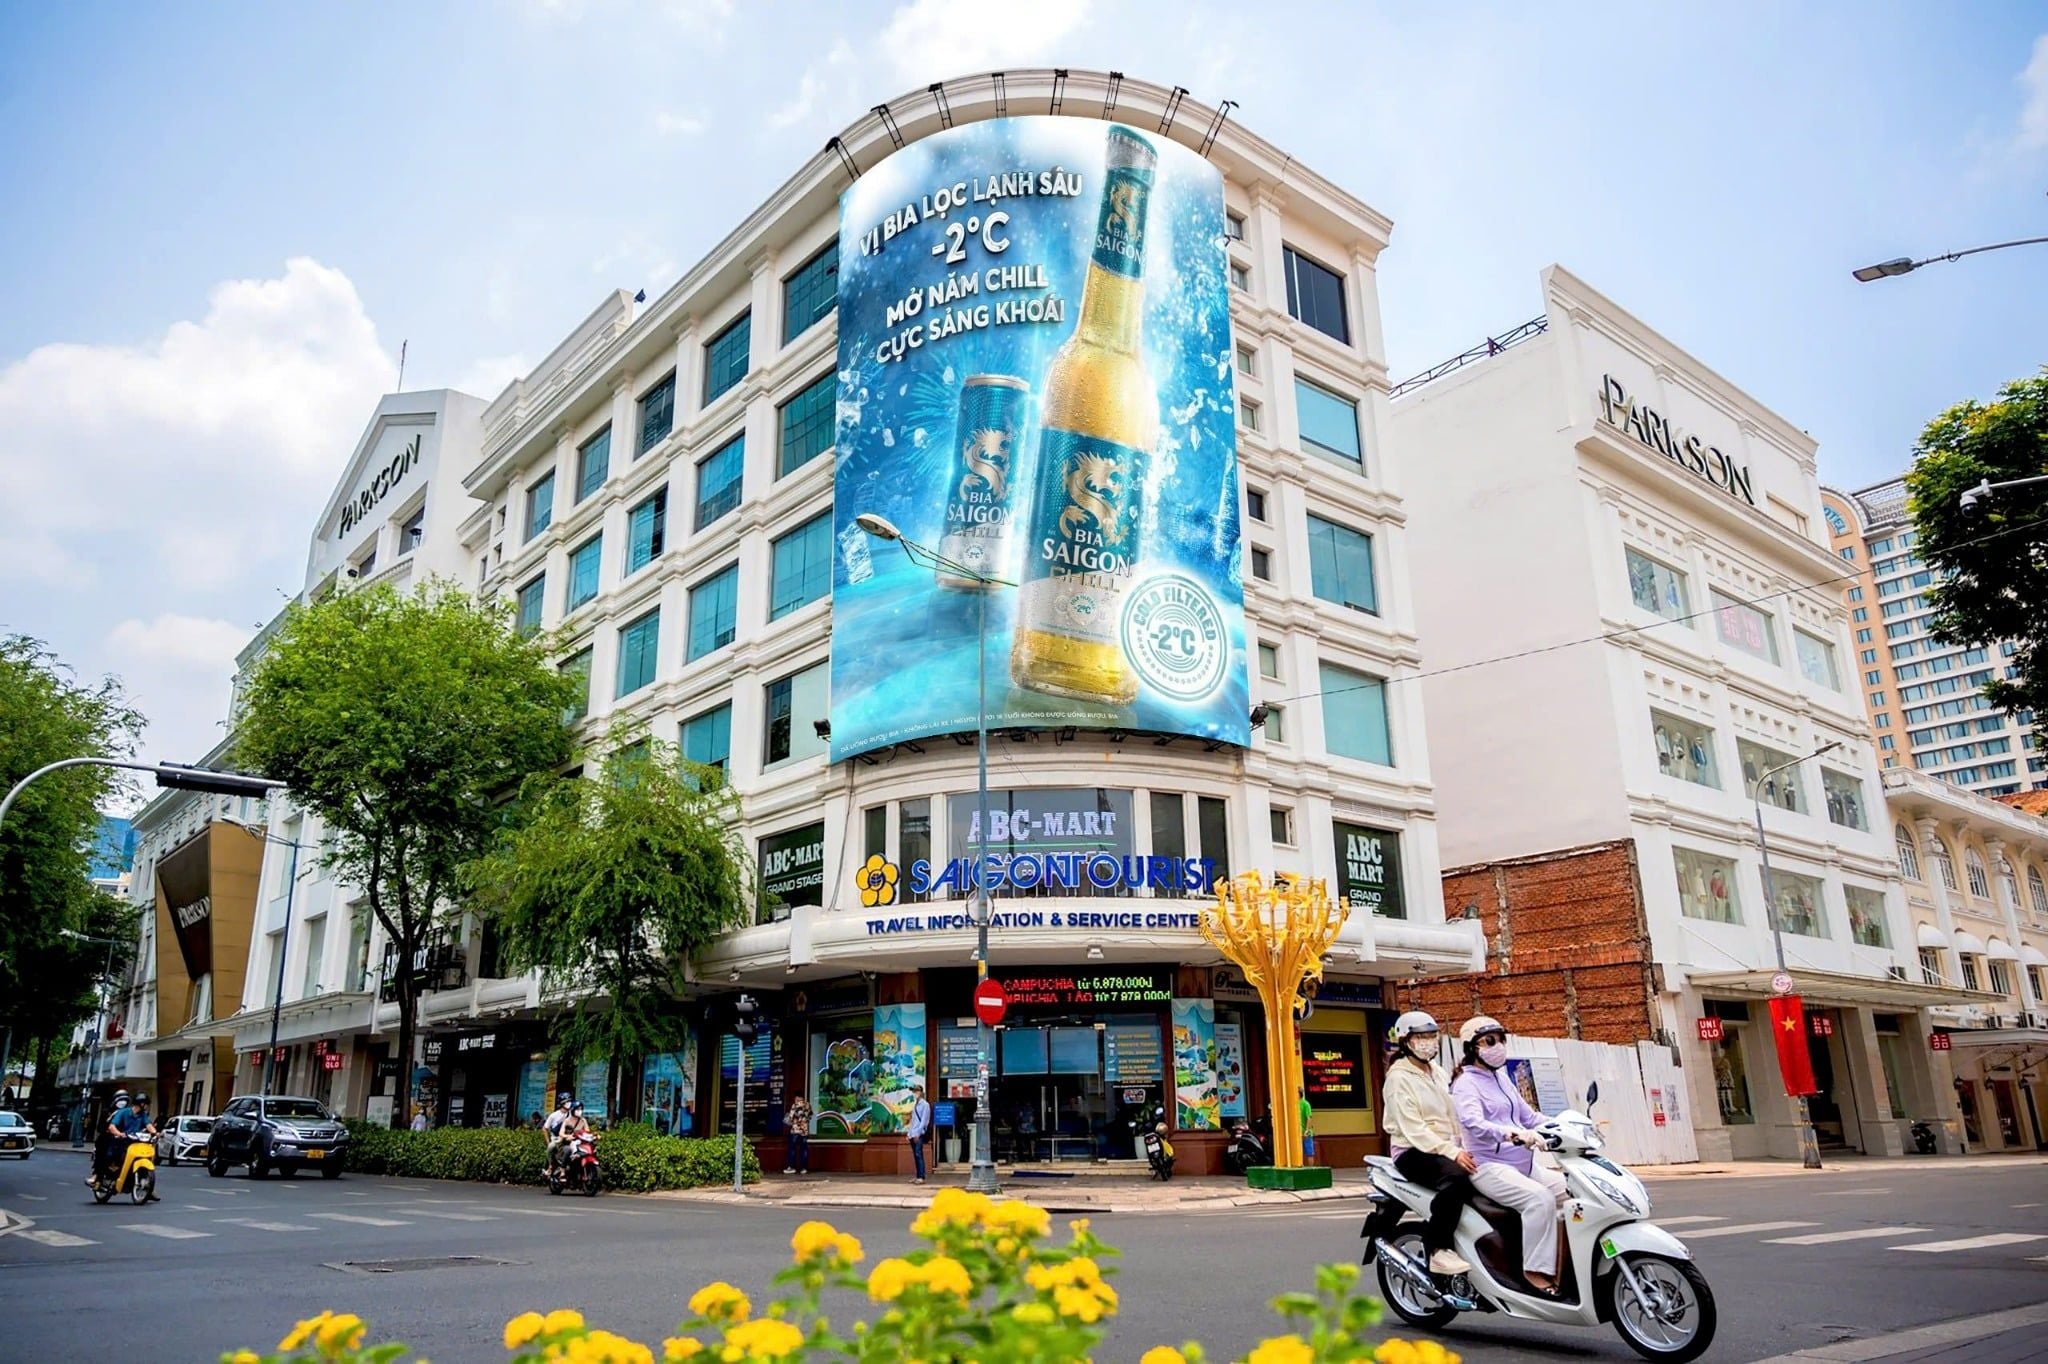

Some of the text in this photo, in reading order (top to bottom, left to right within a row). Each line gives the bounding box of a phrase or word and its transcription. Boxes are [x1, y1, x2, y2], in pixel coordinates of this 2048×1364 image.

[859, 166, 1083, 257] VỊ BIA LỌC LẠNH SÂU
[1114, 227, 1129, 241] BIA
[1096, 233, 1144, 265] SAIGON
[886, 286, 924, 328] MỞ
[985, 264, 1049, 292] CHILL
[876, 294, 1065, 363] CỰC SẢNG KHOÁI
[1599, 373, 1755, 506] PARKSON
[339, 434, 421, 539] PARKSON
[969, 491, 992, 504] BIA
[947, 503, 1012, 525] SAIGON
[1823, 507, 1846, 535] OTEL
[1075, 528, 1104, 548] BIA
[1042, 538, 1131, 578] SAIGON
[1133, 591, 1161, 626] COLD
[1163, 587, 1217, 641] FILTERED
[967, 809, 1116, 843] ABC-MART
[1346, 834, 1383, 865] ABC
[767, 872, 824, 895] GRAND STAGE
[909, 854, 1216, 894] SAIGONTOURIST
[1347, 861, 1384, 883] MART
[1350, 889, 1382, 903] GRAND
[866, 912, 1211, 935] TRAVEL INFORATION & SERVICE CENTE
[1700, 1019, 1716, 1029] UNI
[1701, 1029, 1719, 1040] QLO
[325, 1061, 340, 1069] QLO
[486, 1101, 506, 1111] ABC
